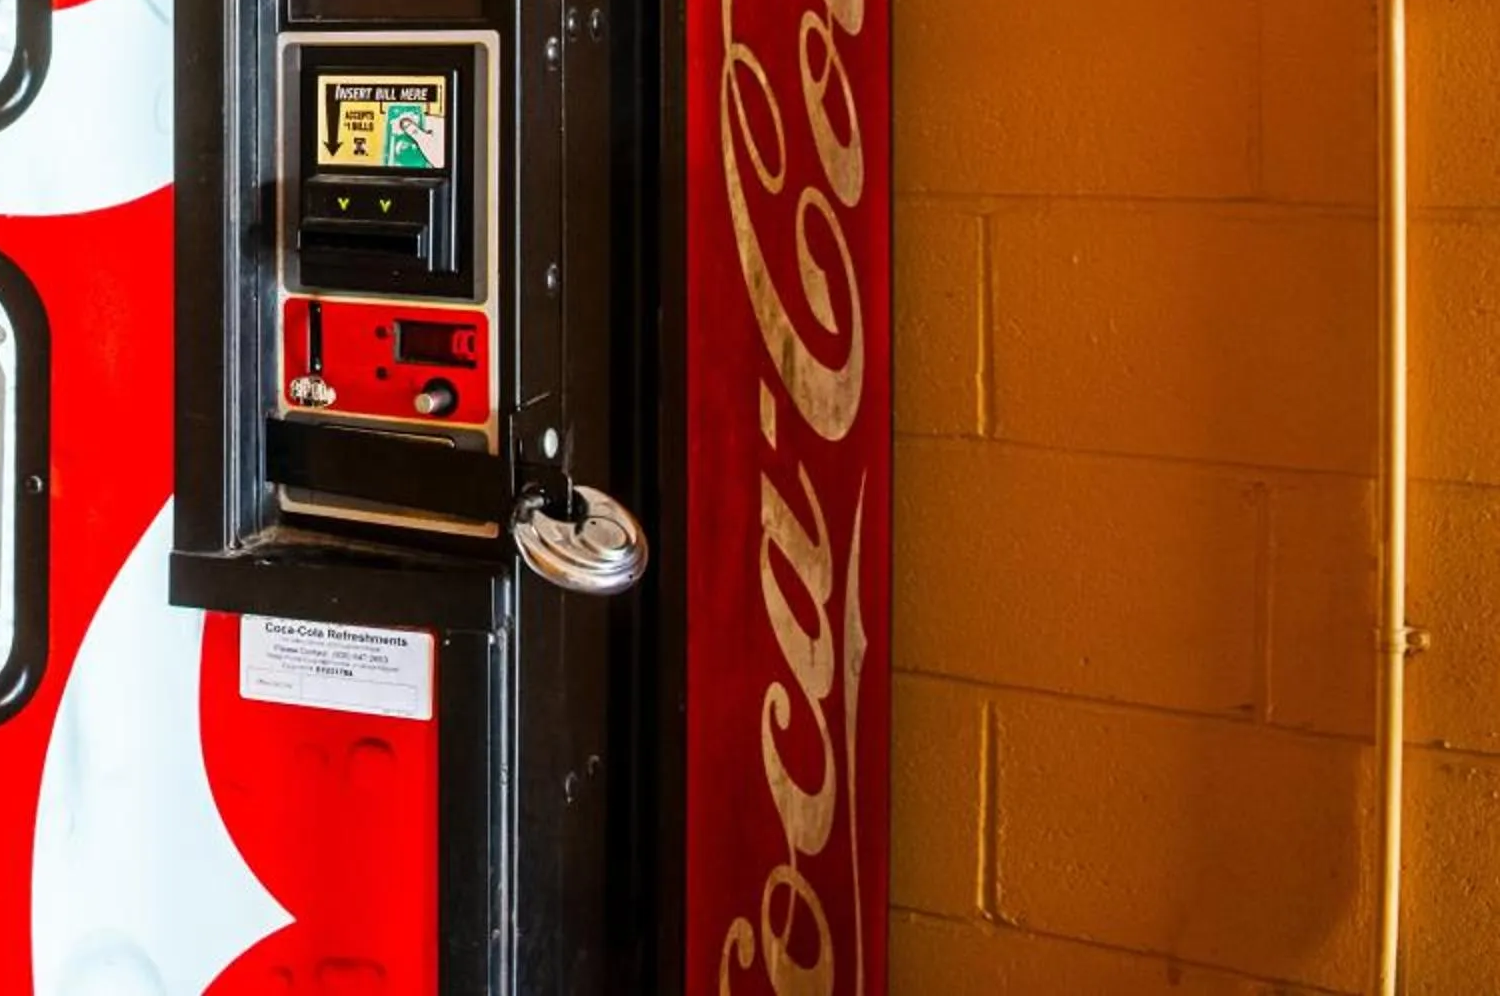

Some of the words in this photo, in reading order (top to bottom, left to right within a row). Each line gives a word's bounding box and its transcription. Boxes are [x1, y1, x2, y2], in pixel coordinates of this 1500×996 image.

[335, 86, 372, 101] INSERT
[375, 87, 396, 101] BILL
[400, 87, 428, 101] HERE
[265, 621, 324, 639] Coca-Cola
[327, 628, 408, 647] Refreshments
